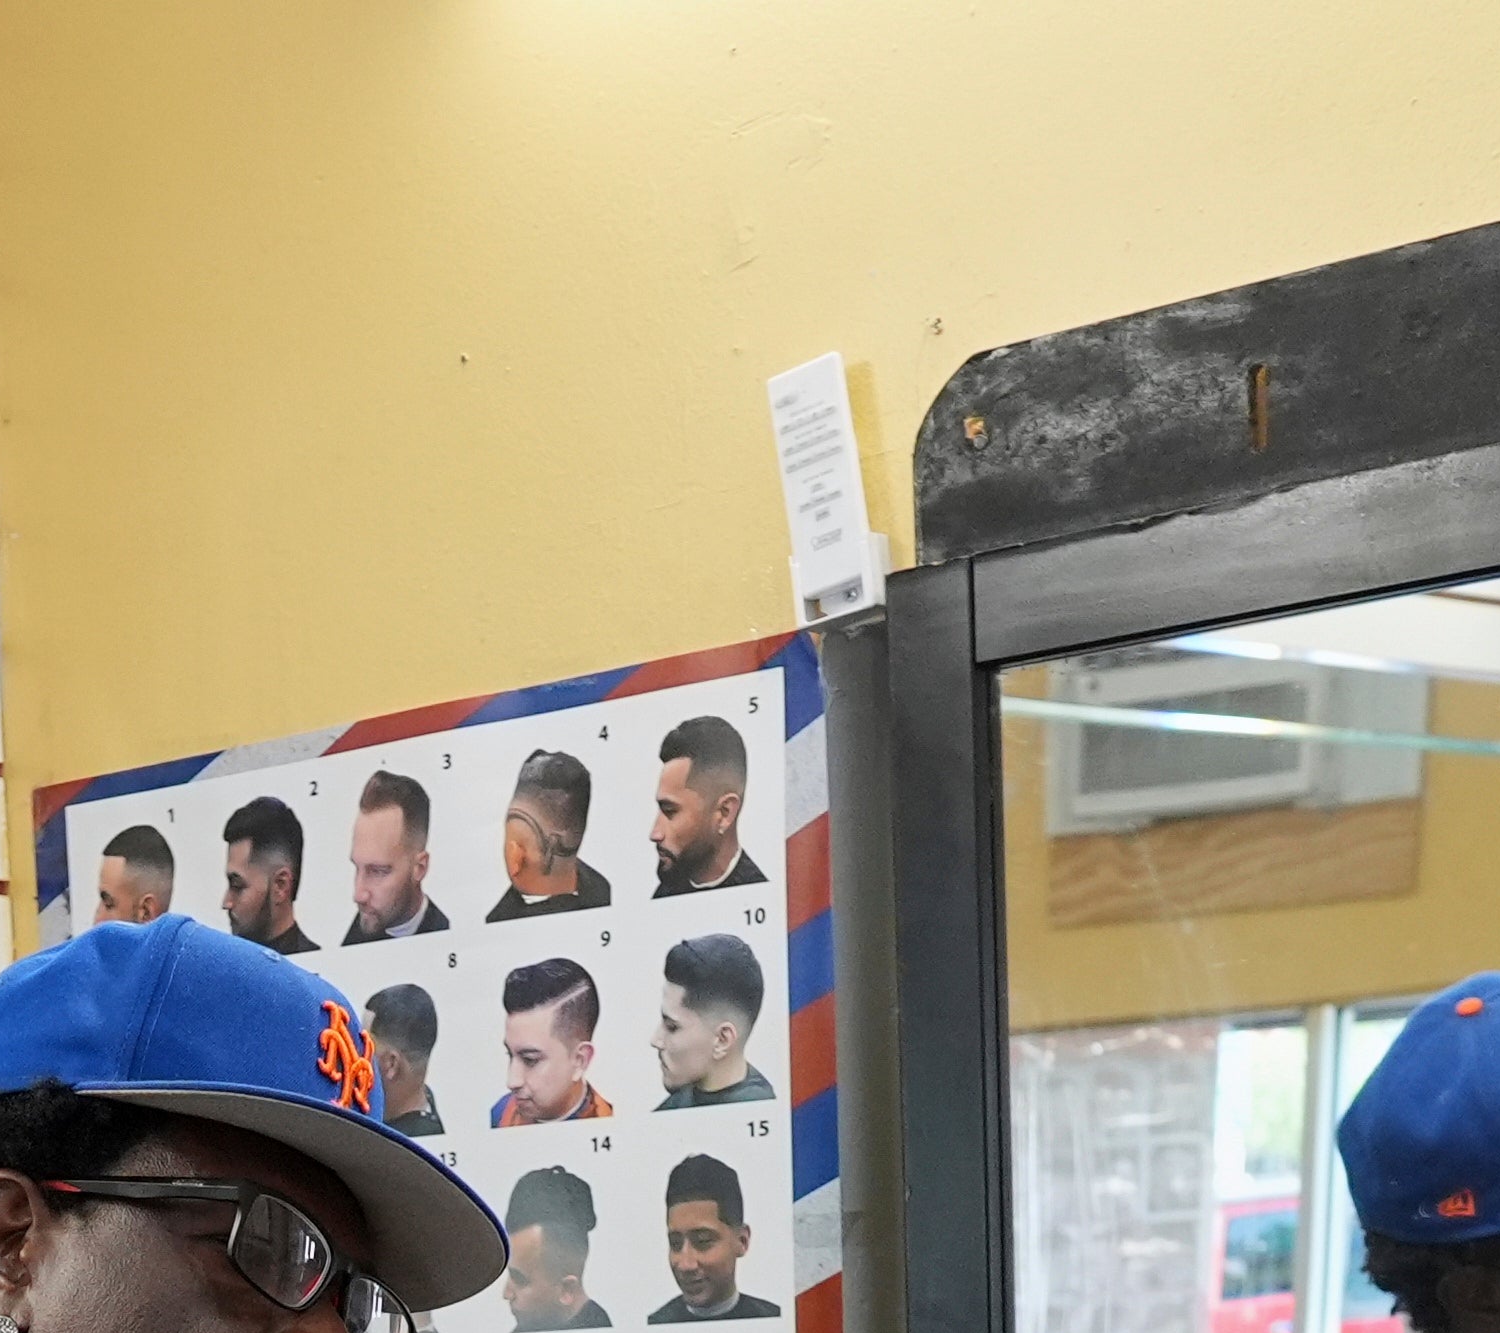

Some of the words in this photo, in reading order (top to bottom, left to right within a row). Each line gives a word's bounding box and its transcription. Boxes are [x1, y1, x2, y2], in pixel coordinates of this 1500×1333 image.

[748, 696, 759, 714] 5
[598, 724, 609, 741] 4
[442, 752, 452, 770] 3
[309, 780, 319, 797] 2
[167, 808, 174, 824] 1
[743, 907, 767, 926] 10
[600, 930, 611, 947] 9
[447, 952, 458, 969] 8
[747, 1120, 770, 1138] 15
[591, 1136, 612, 1153] 14
